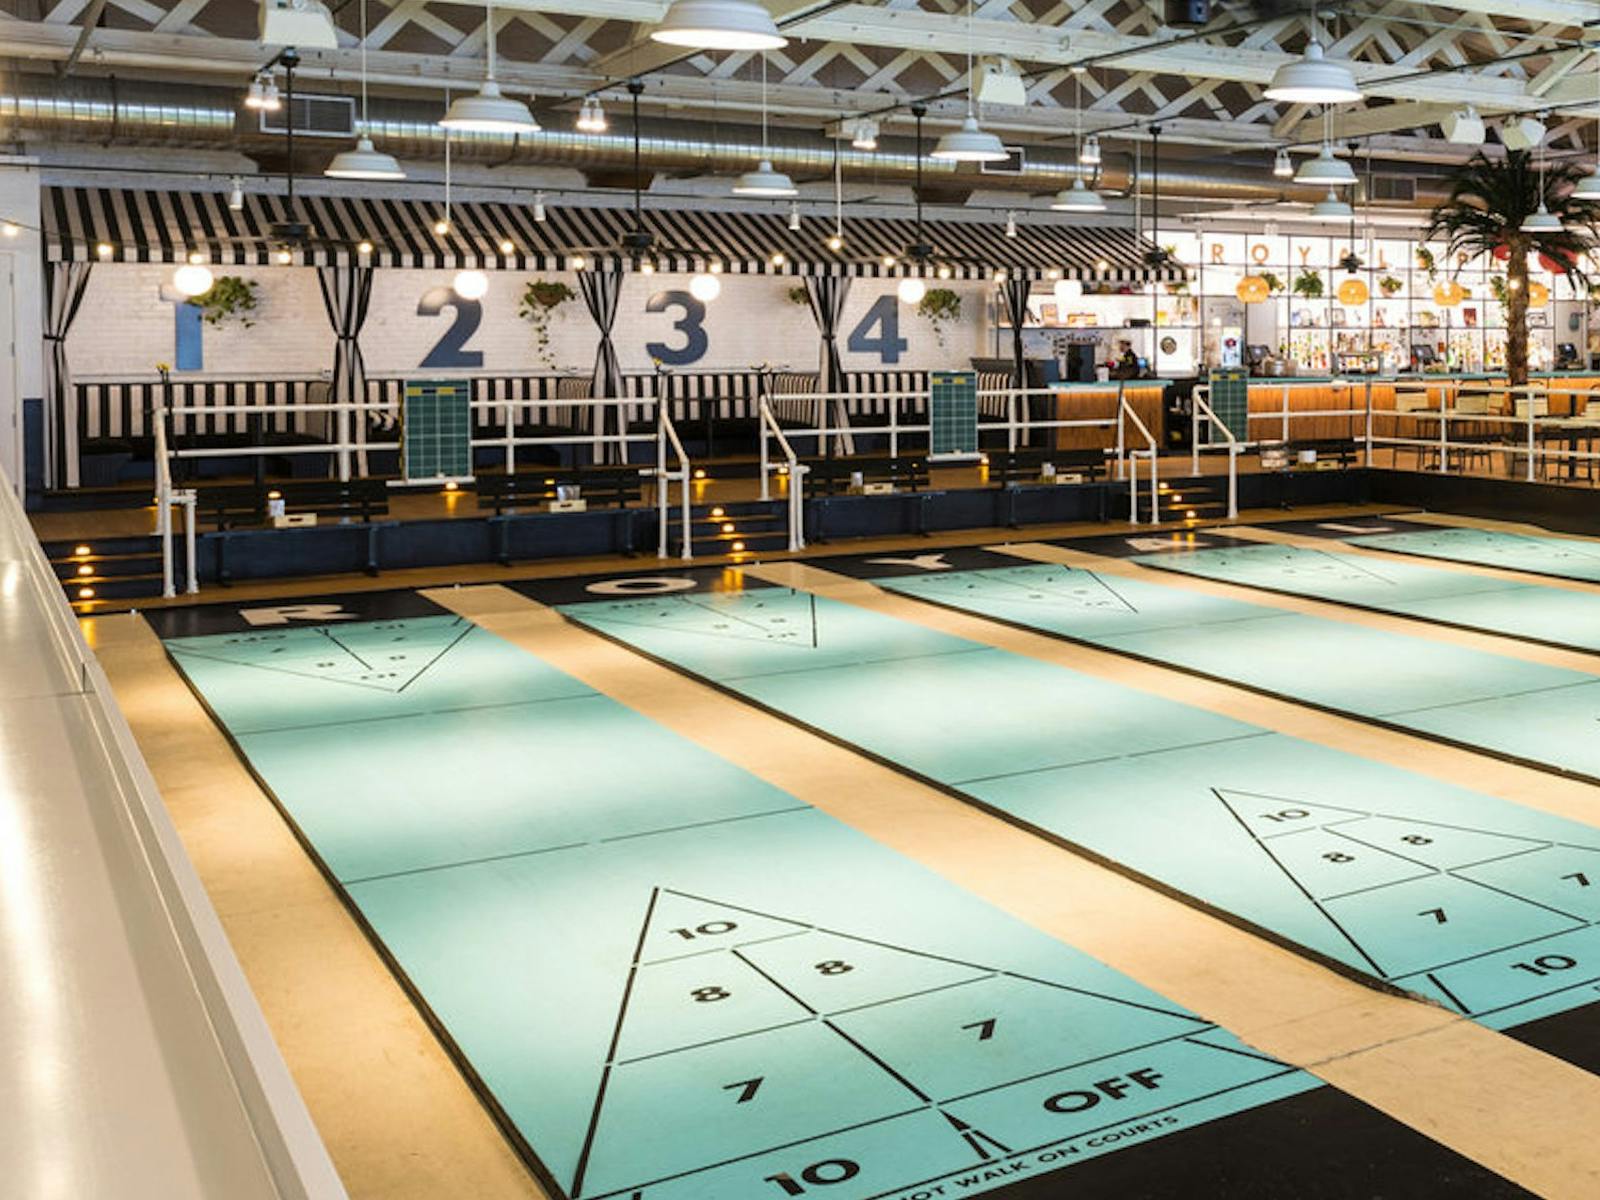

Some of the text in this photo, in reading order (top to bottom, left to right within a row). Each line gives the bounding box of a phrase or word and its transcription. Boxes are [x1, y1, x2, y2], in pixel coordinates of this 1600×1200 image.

[417, 286, 483, 368] 2
[646, 290, 708, 365] 3
[848, 295, 907, 364] 4
[1259, 807, 1311, 823] 10
[1400, 834, 1434, 847] 8
[1322, 851, 1356, 864] 8
[1561, 872, 1591, 887] 7
[1416, 907, 1449, 925] 7
[669, 920, 738, 940] 10
[814, 960, 854, 976] 8
[1511, 954, 1578, 977] 10
[690, 986, 731, 1003] 8
[962, 1018, 997, 1041] 7
[722, 1076, 765, 1105] 7
[1043, 1067, 1165, 1114] OFF
[955, 1161, 1031, 1188] WALK
[1037, 1146, 1081, 1164] ON
[1087, 1115, 1179, 1149] COURTS
[763, 1158, 861, 1197] 10
